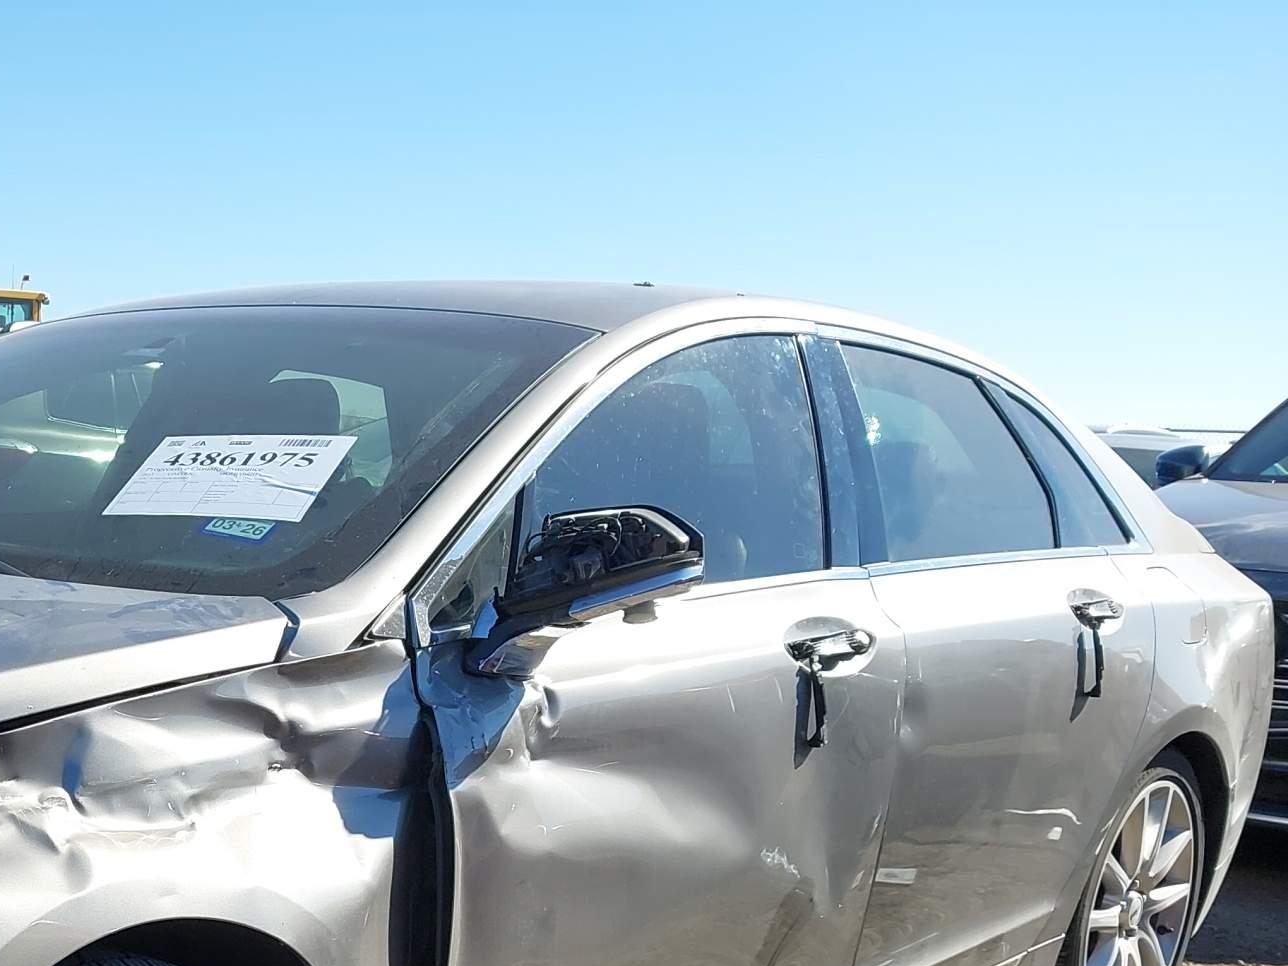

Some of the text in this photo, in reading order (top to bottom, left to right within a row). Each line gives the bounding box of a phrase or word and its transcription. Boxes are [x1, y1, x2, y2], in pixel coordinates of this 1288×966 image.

[164, 451, 320, 468] 43861975
[212, 518, 266, 536] 03 26
